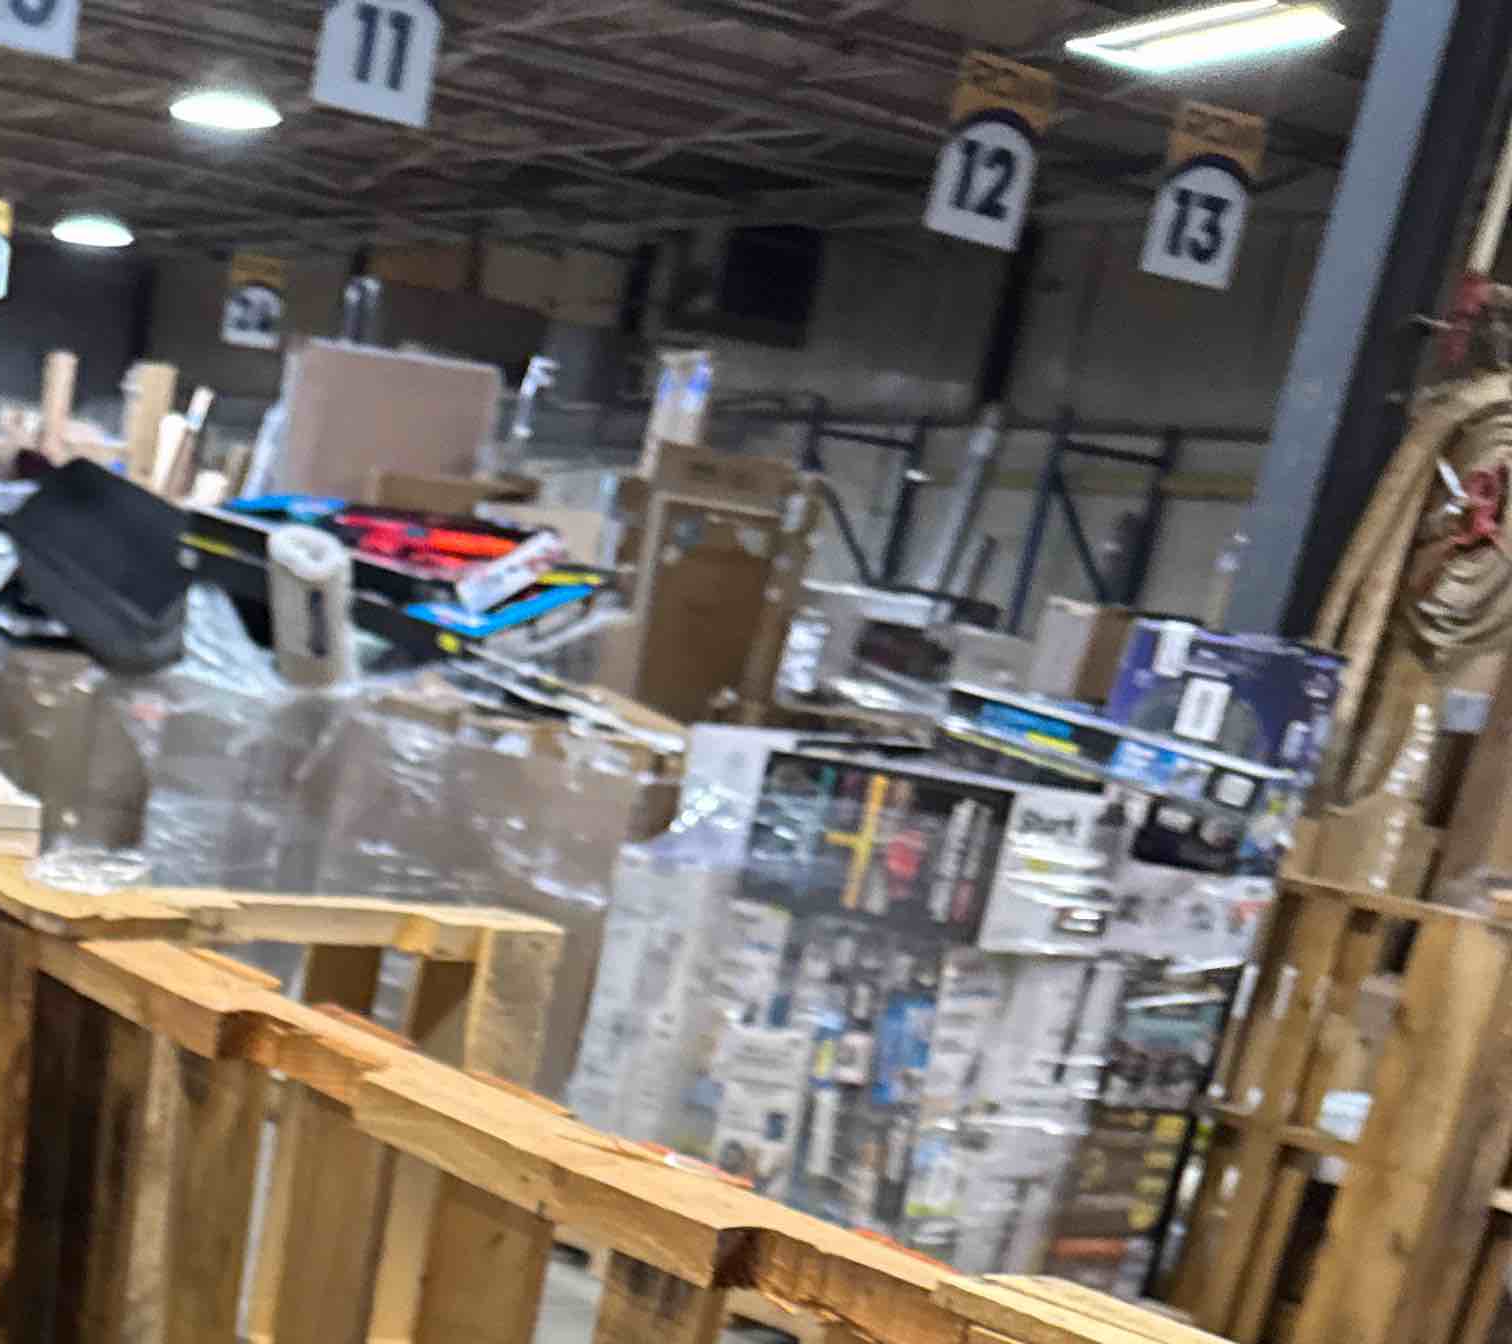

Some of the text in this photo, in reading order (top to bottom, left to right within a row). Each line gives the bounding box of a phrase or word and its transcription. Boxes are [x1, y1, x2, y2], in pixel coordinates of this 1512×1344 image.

[355, 3, 412, 91] 11
[953, 138, 1017, 222] 12
[1164, 186, 1231, 265] 13
